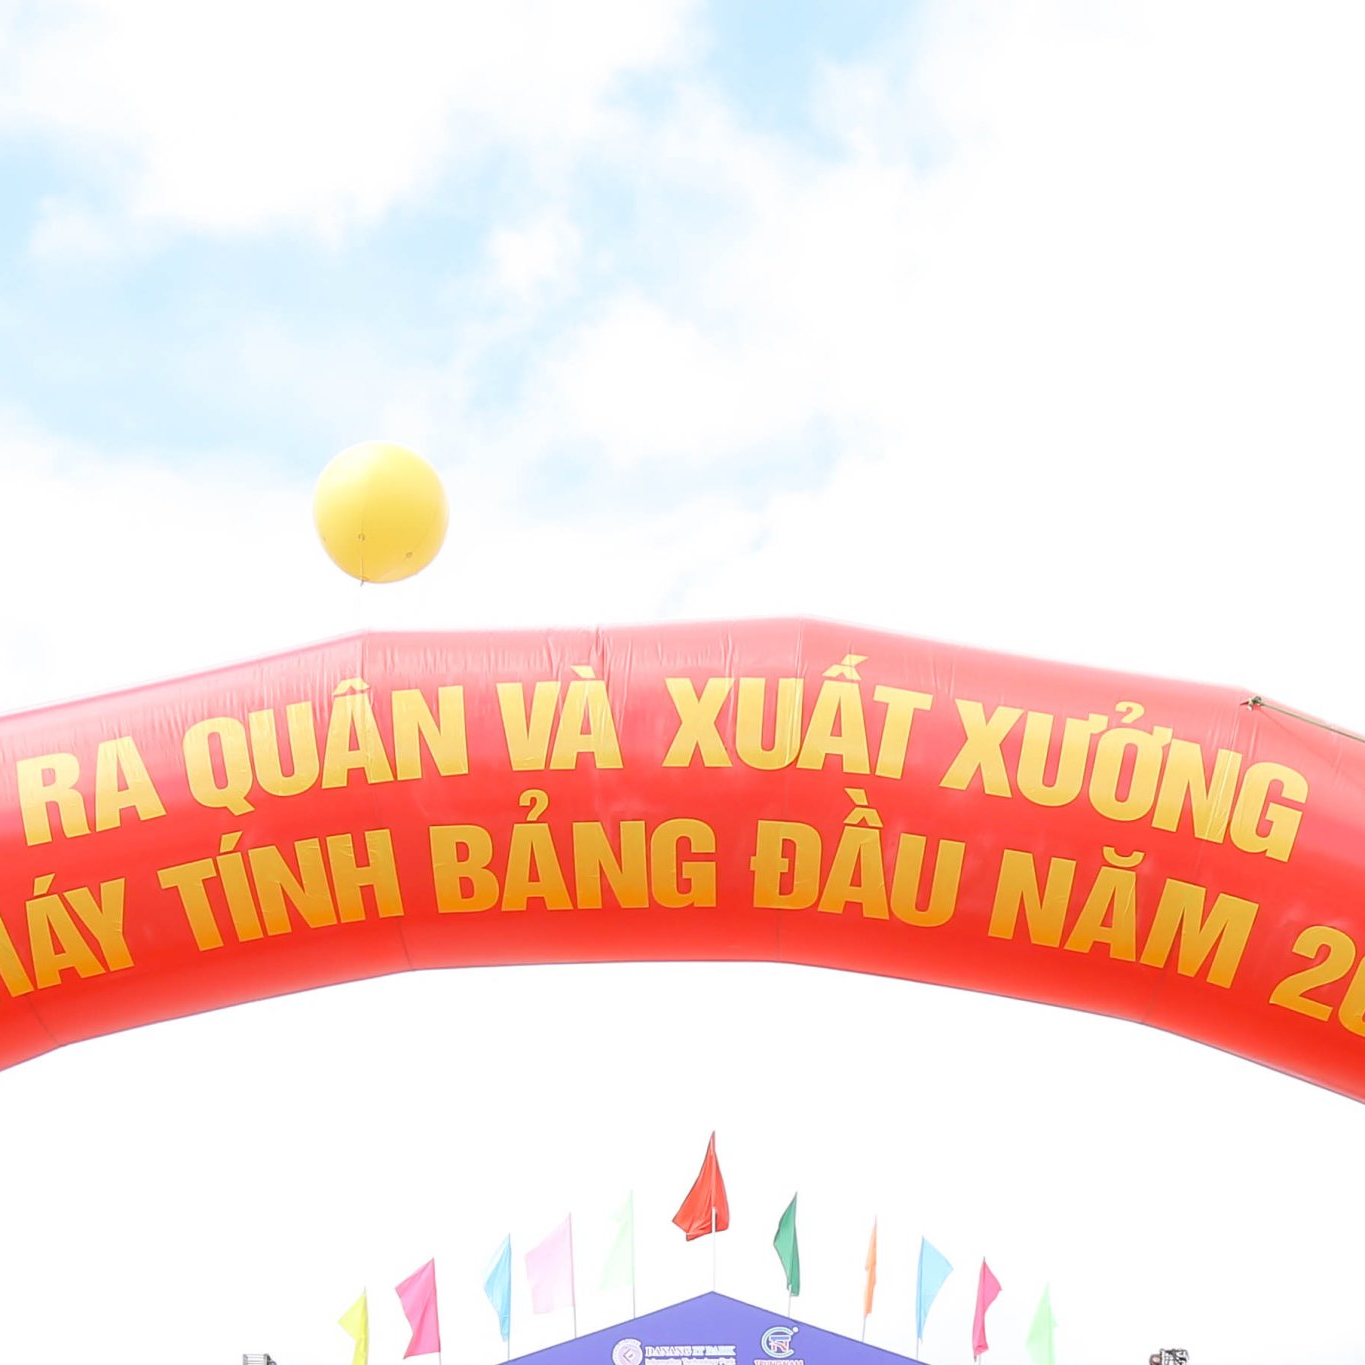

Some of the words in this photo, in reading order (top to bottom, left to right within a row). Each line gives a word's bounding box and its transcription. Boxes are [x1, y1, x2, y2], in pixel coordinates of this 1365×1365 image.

[16, 736, 166, 846] RA
[182, 677, 469, 814] QUÂN
[496, 666, 623, 772] VÀ
[662, 653, 932, 780] XUẤT
[941, 701, 1309, 862] XƯỞNG
[159, 833, 404, 953] TÍNH
[429, 789, 716, 913] BẢNG
[751, 787, 964, 927] ĐẦU
[988, 850, 1259, 989] NĂM
